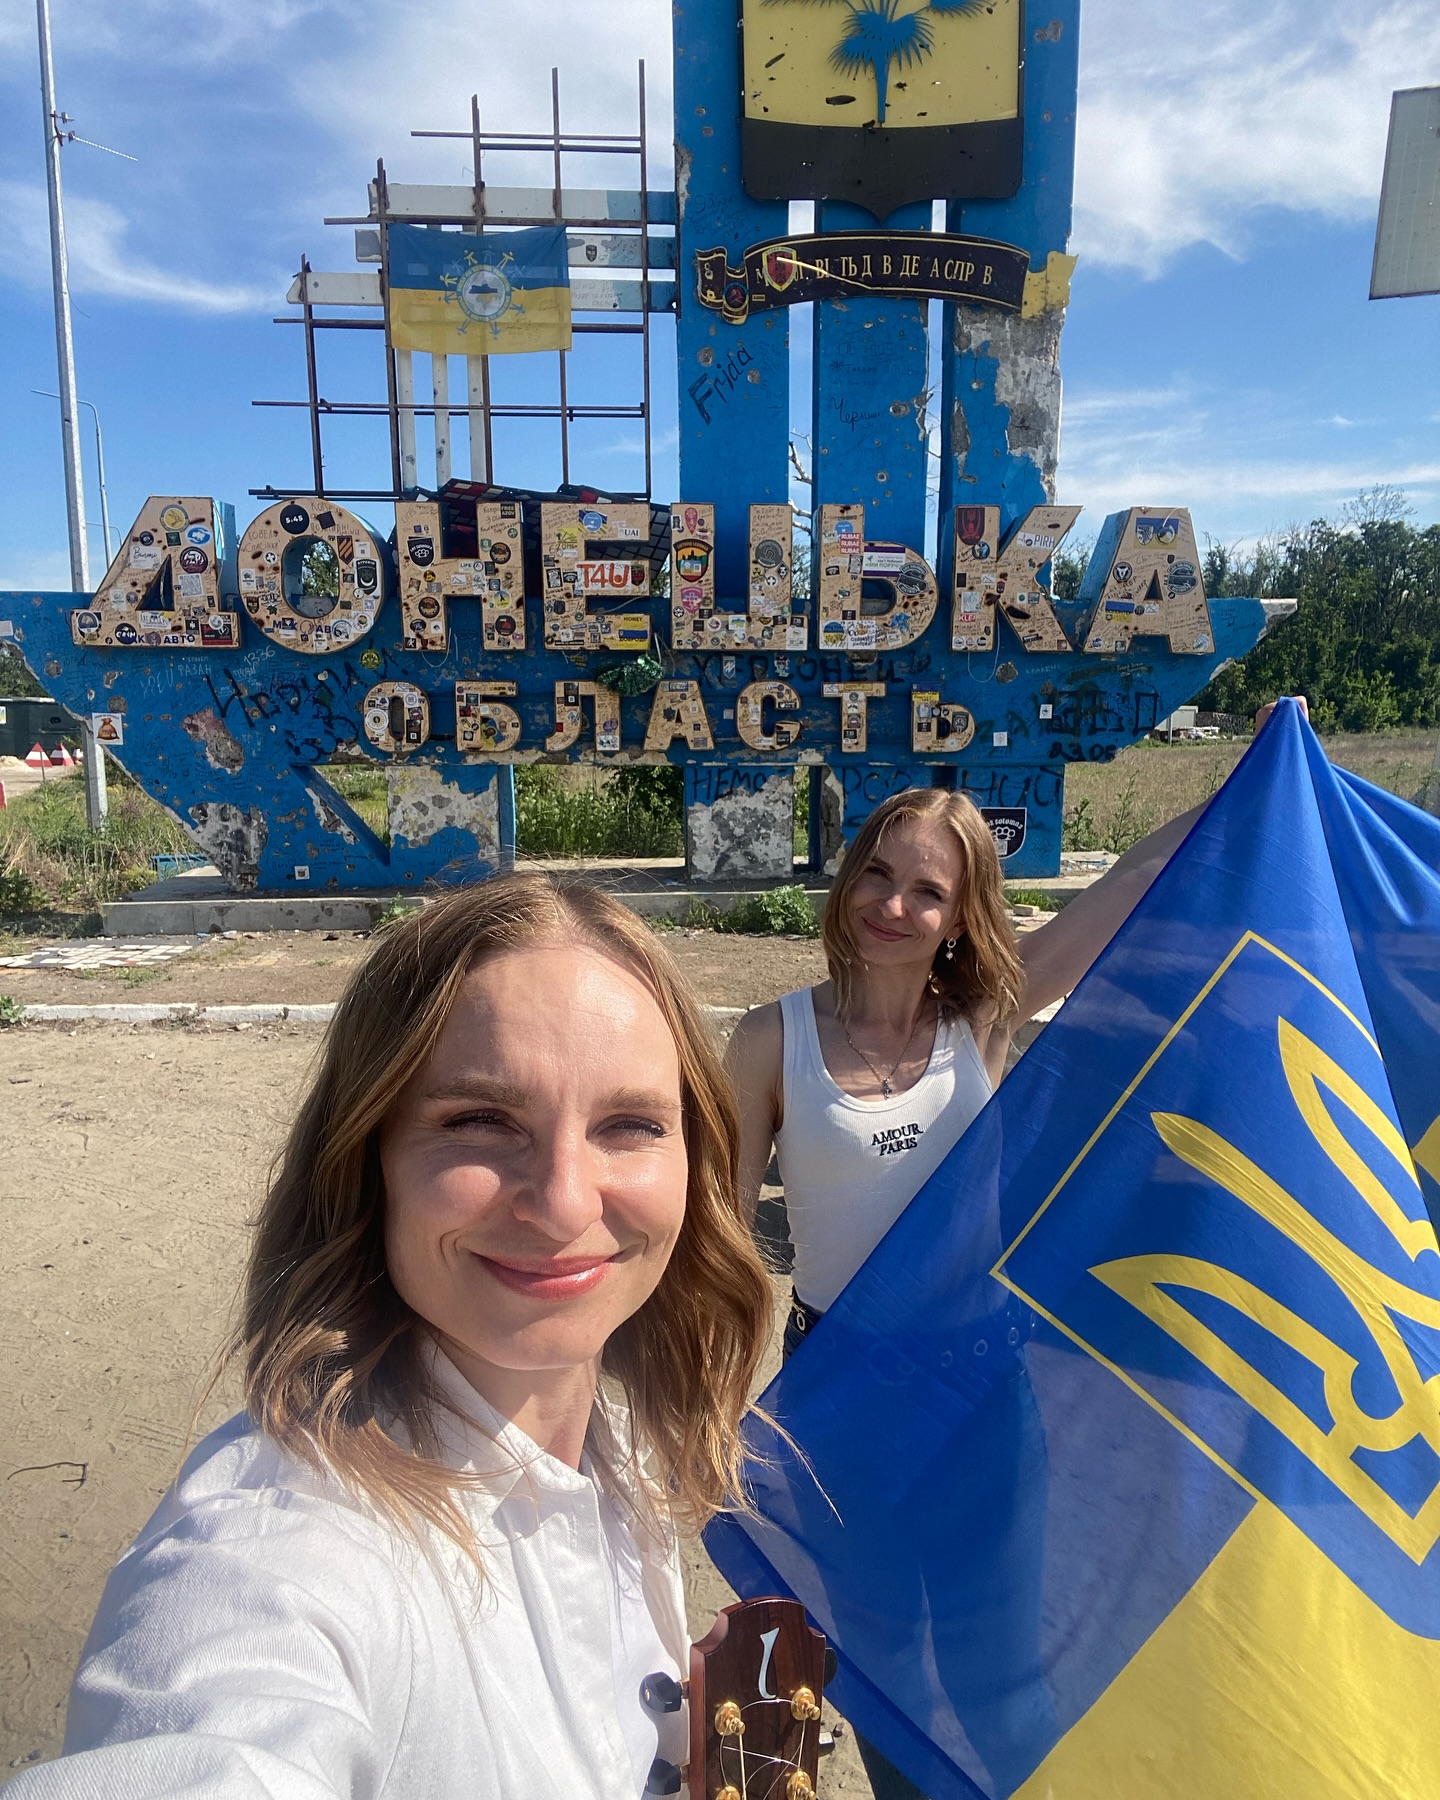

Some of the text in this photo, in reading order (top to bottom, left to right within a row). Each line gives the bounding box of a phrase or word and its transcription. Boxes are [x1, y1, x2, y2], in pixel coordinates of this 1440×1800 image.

[688, 347, 754, 426] Frida
[624, 529, 639, 537] UAI
[71, 496, 1216, 655] ДОНЕЦЬКА
[576, 563, 630, 589] T4U
[163, 634, 196, 645] АВТО
[363, 680, 977, 753] ОБЛАСТЬ
[871, 1122, 924, 1146] AMOUR
[879, 1137, 918, 1156] PARIS
